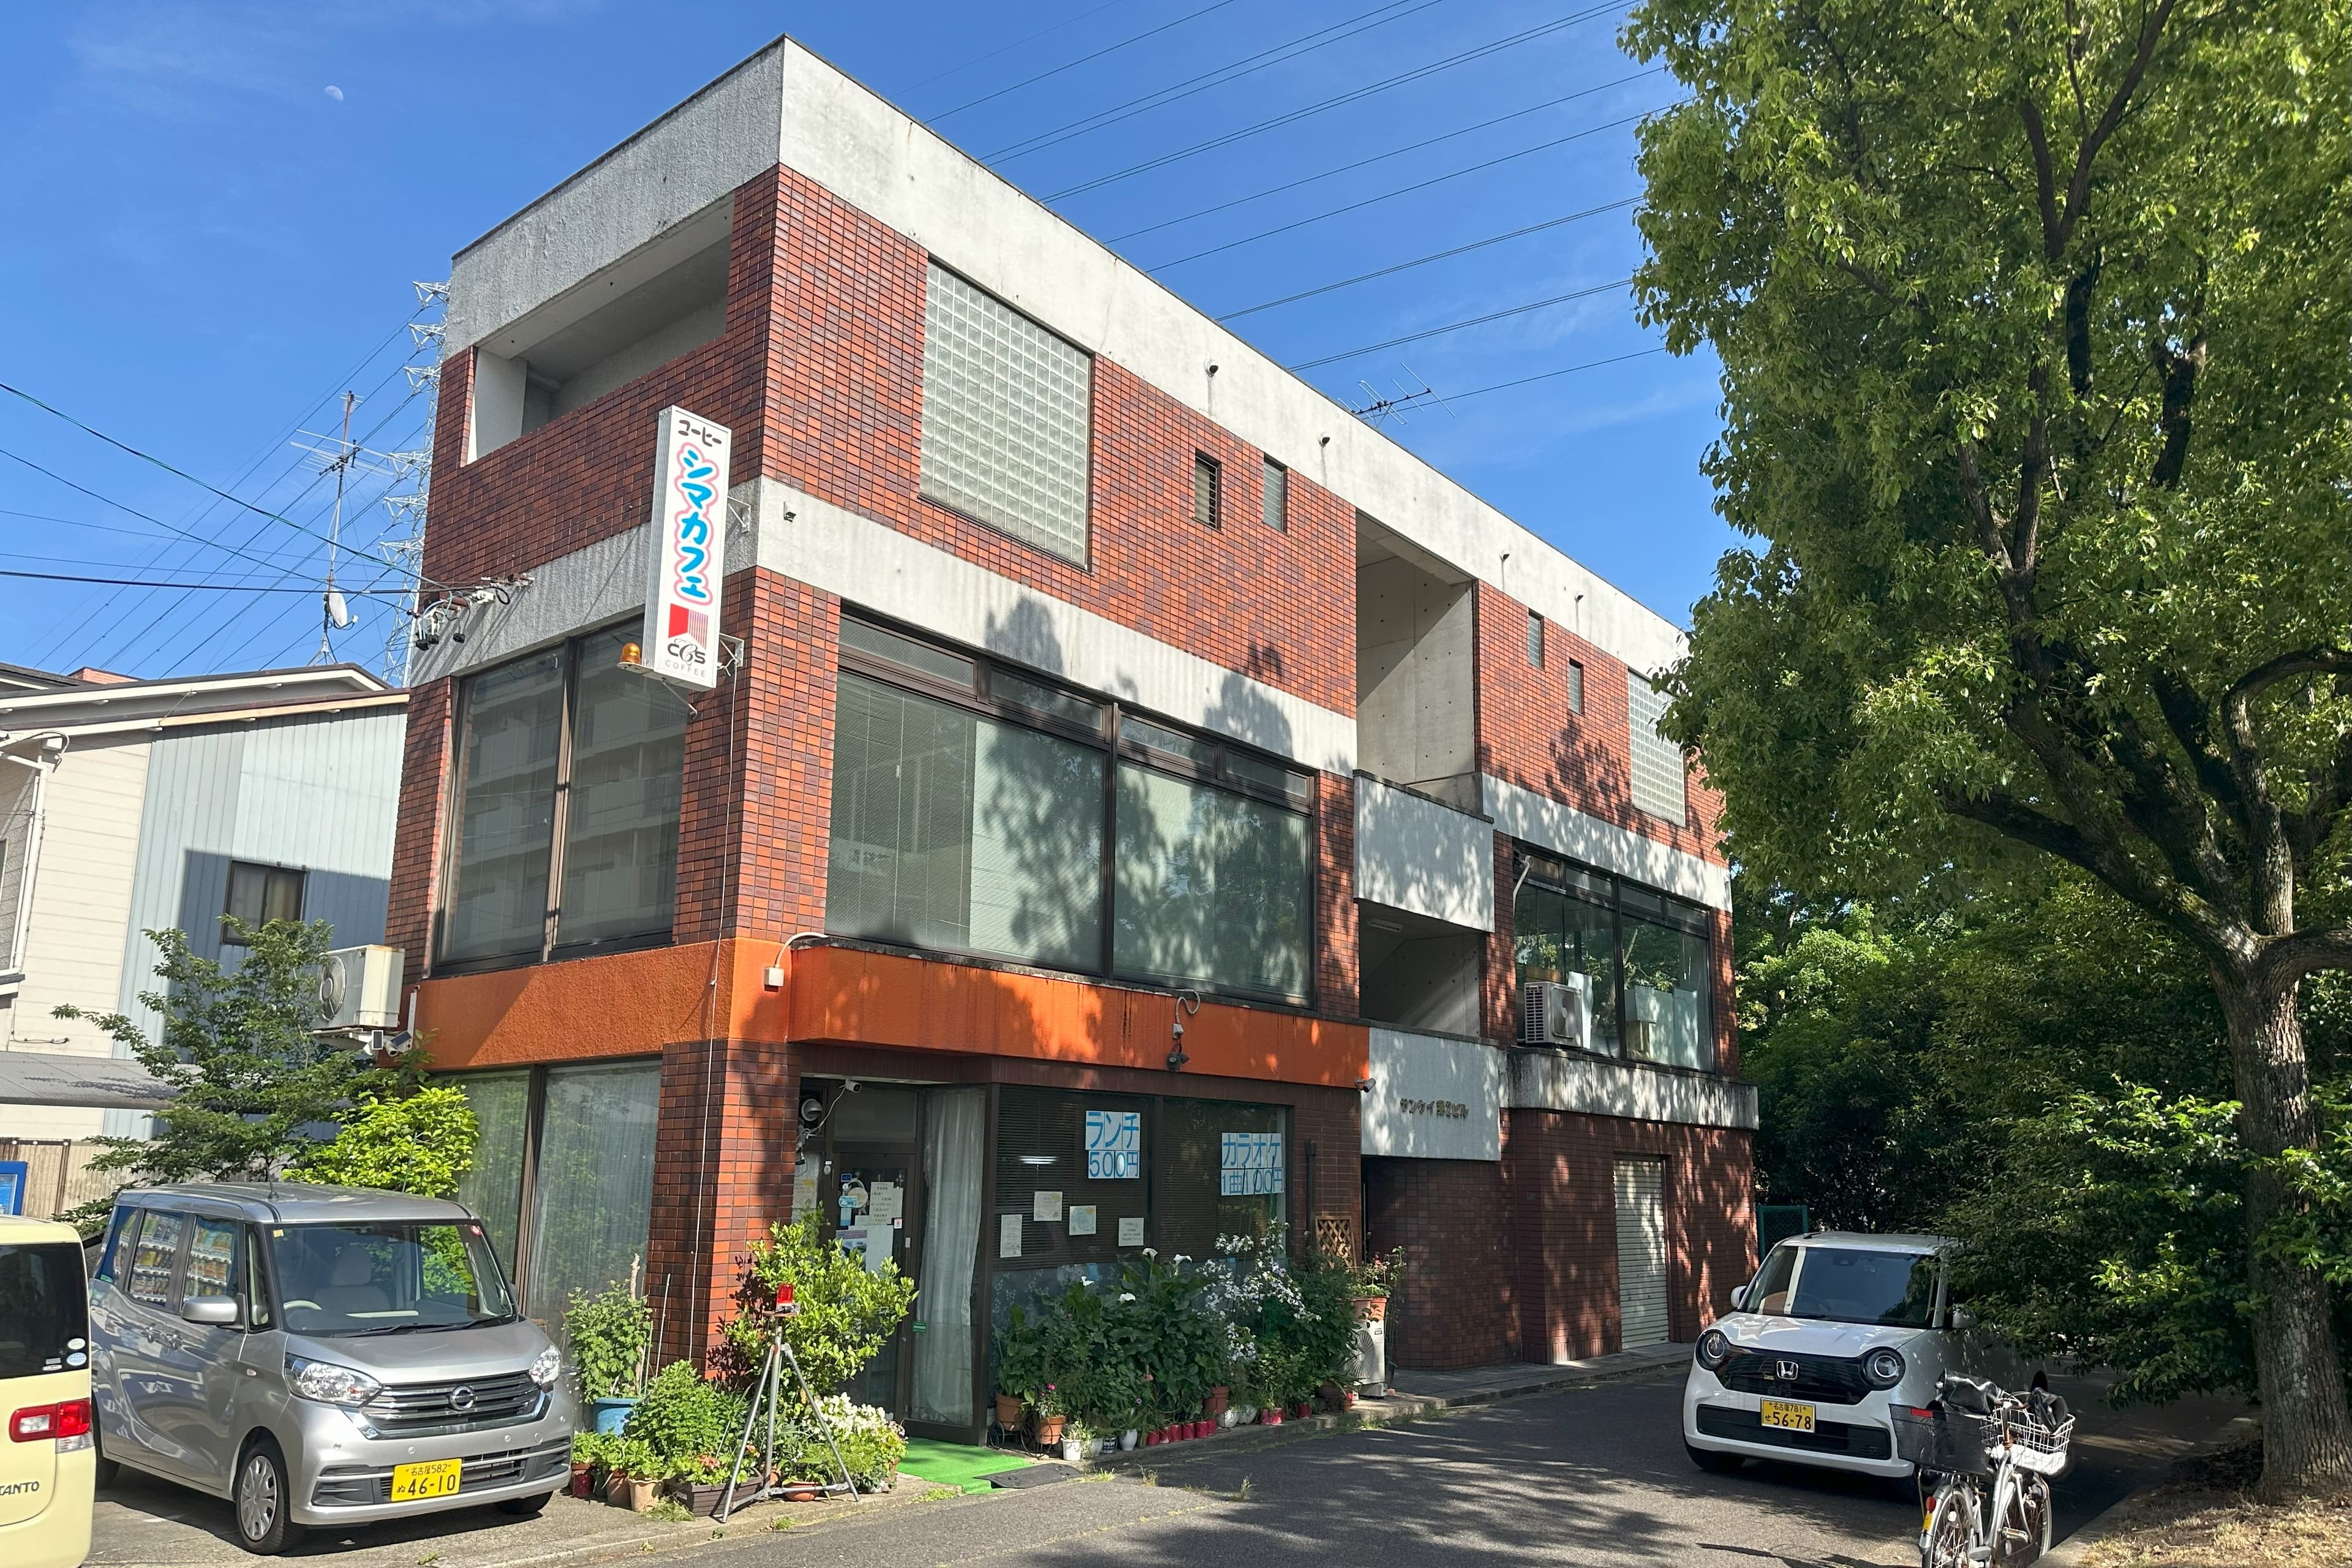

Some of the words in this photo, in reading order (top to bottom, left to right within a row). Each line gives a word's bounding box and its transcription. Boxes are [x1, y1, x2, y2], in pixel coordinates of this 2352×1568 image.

[678, 420, 722, 447] コーヒー
[680, 449, 714, 599] シマカフェ
[665, 660, 706, 677] COFFEE
[1087, 1112, 1139, 1148] ランチ
[1223, 1134, 1280, 1167] カラオケ
[1090, 1152, 1139, 1177] 500円
[1222, 1169, 1283, 1194] 1曲100円
[1773, 1411, 1811, 1430] 56-78
[407, 1474, 456, 1496] 46-10
